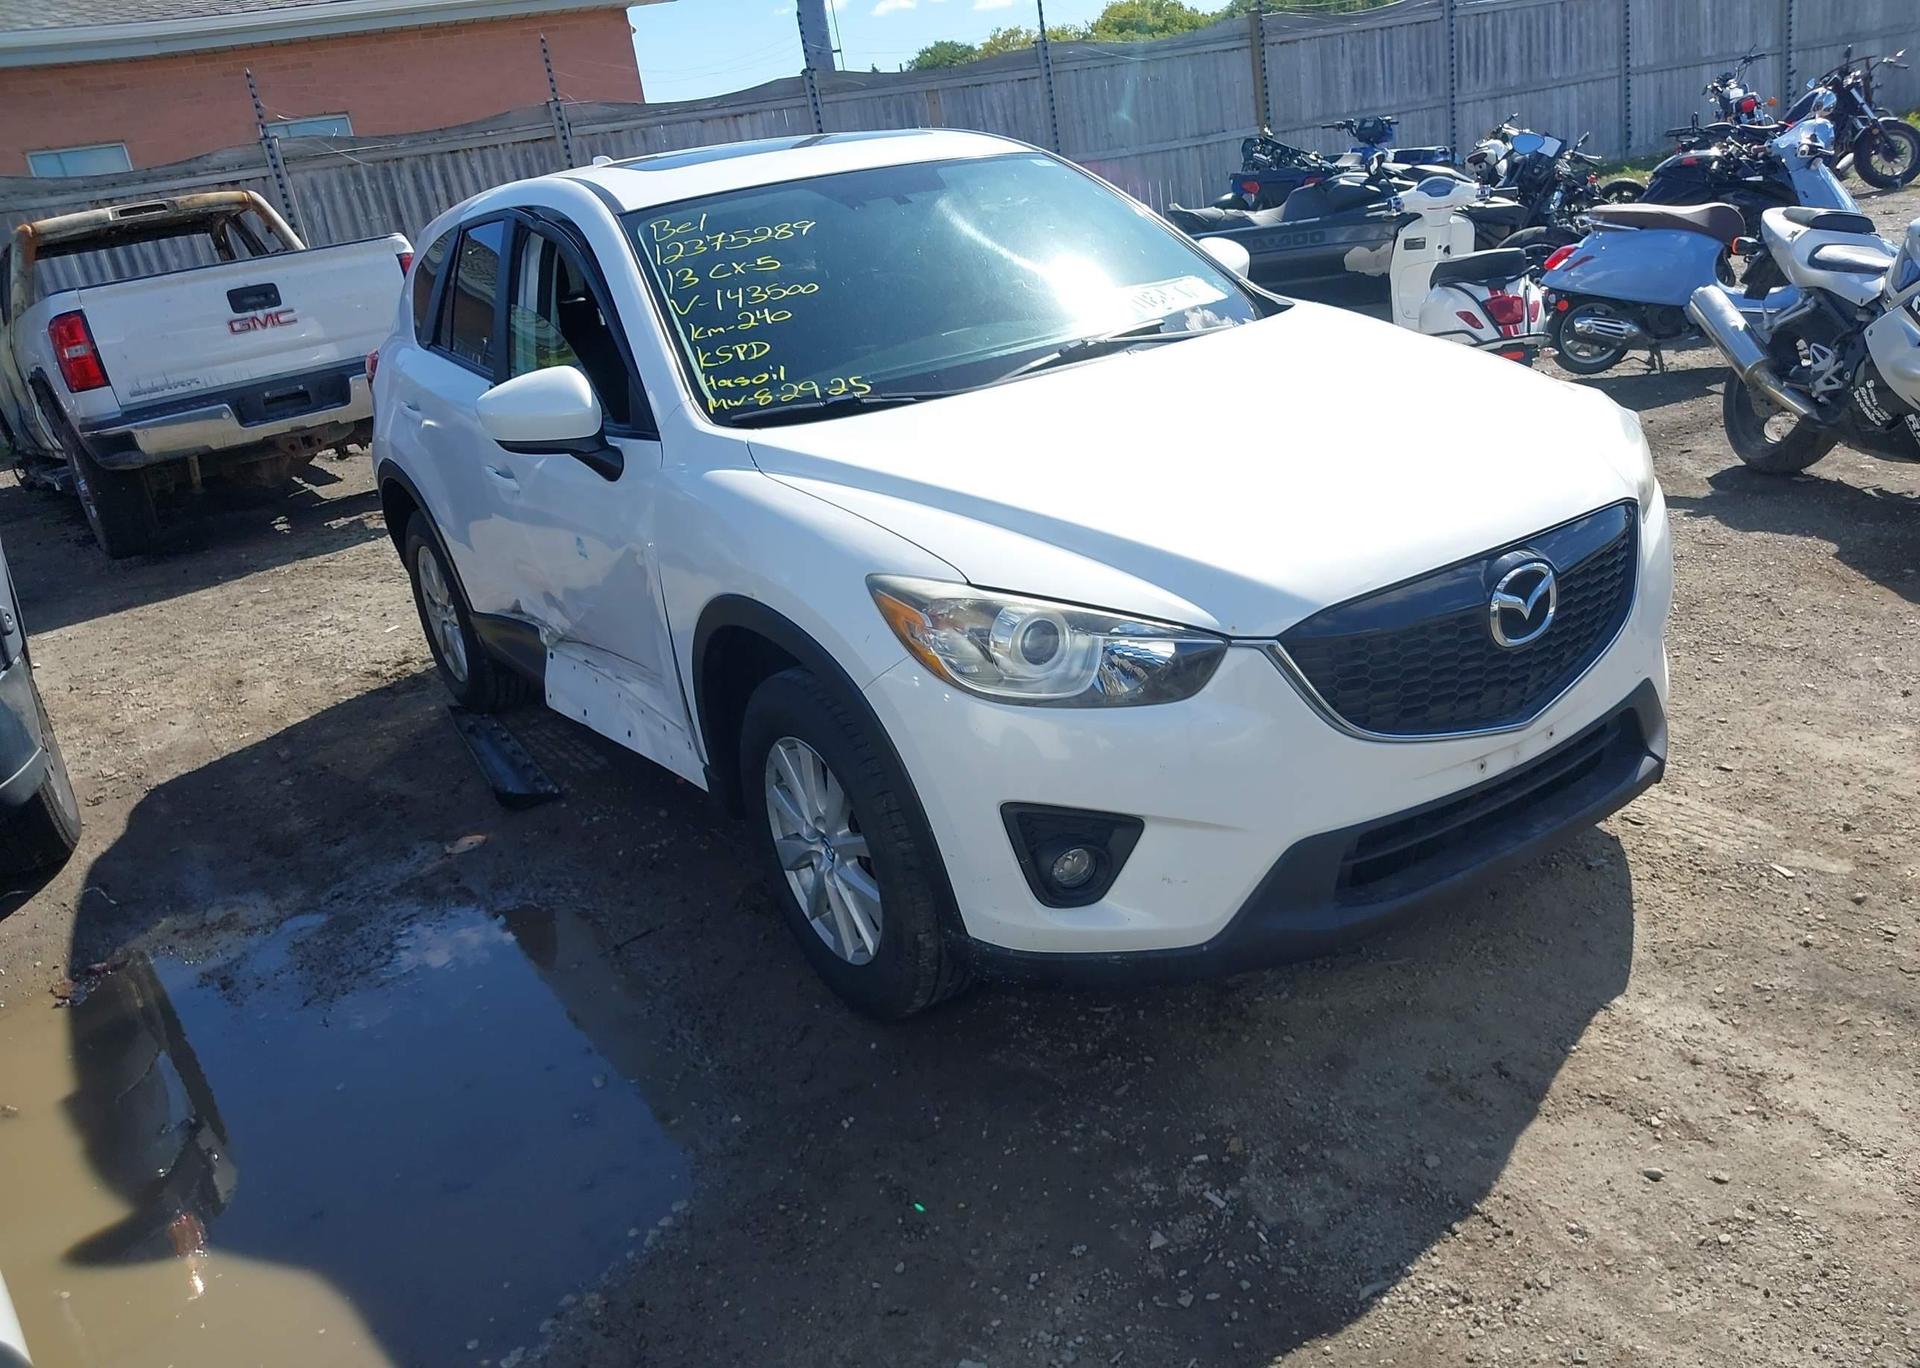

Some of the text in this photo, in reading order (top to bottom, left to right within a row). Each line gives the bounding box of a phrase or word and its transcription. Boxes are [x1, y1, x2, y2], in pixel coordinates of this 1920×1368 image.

[656, 220, 816, 265] 12375289
[667, 256, 781, 294] 13 CX-5
[228, 308, 298, 335] GMC
